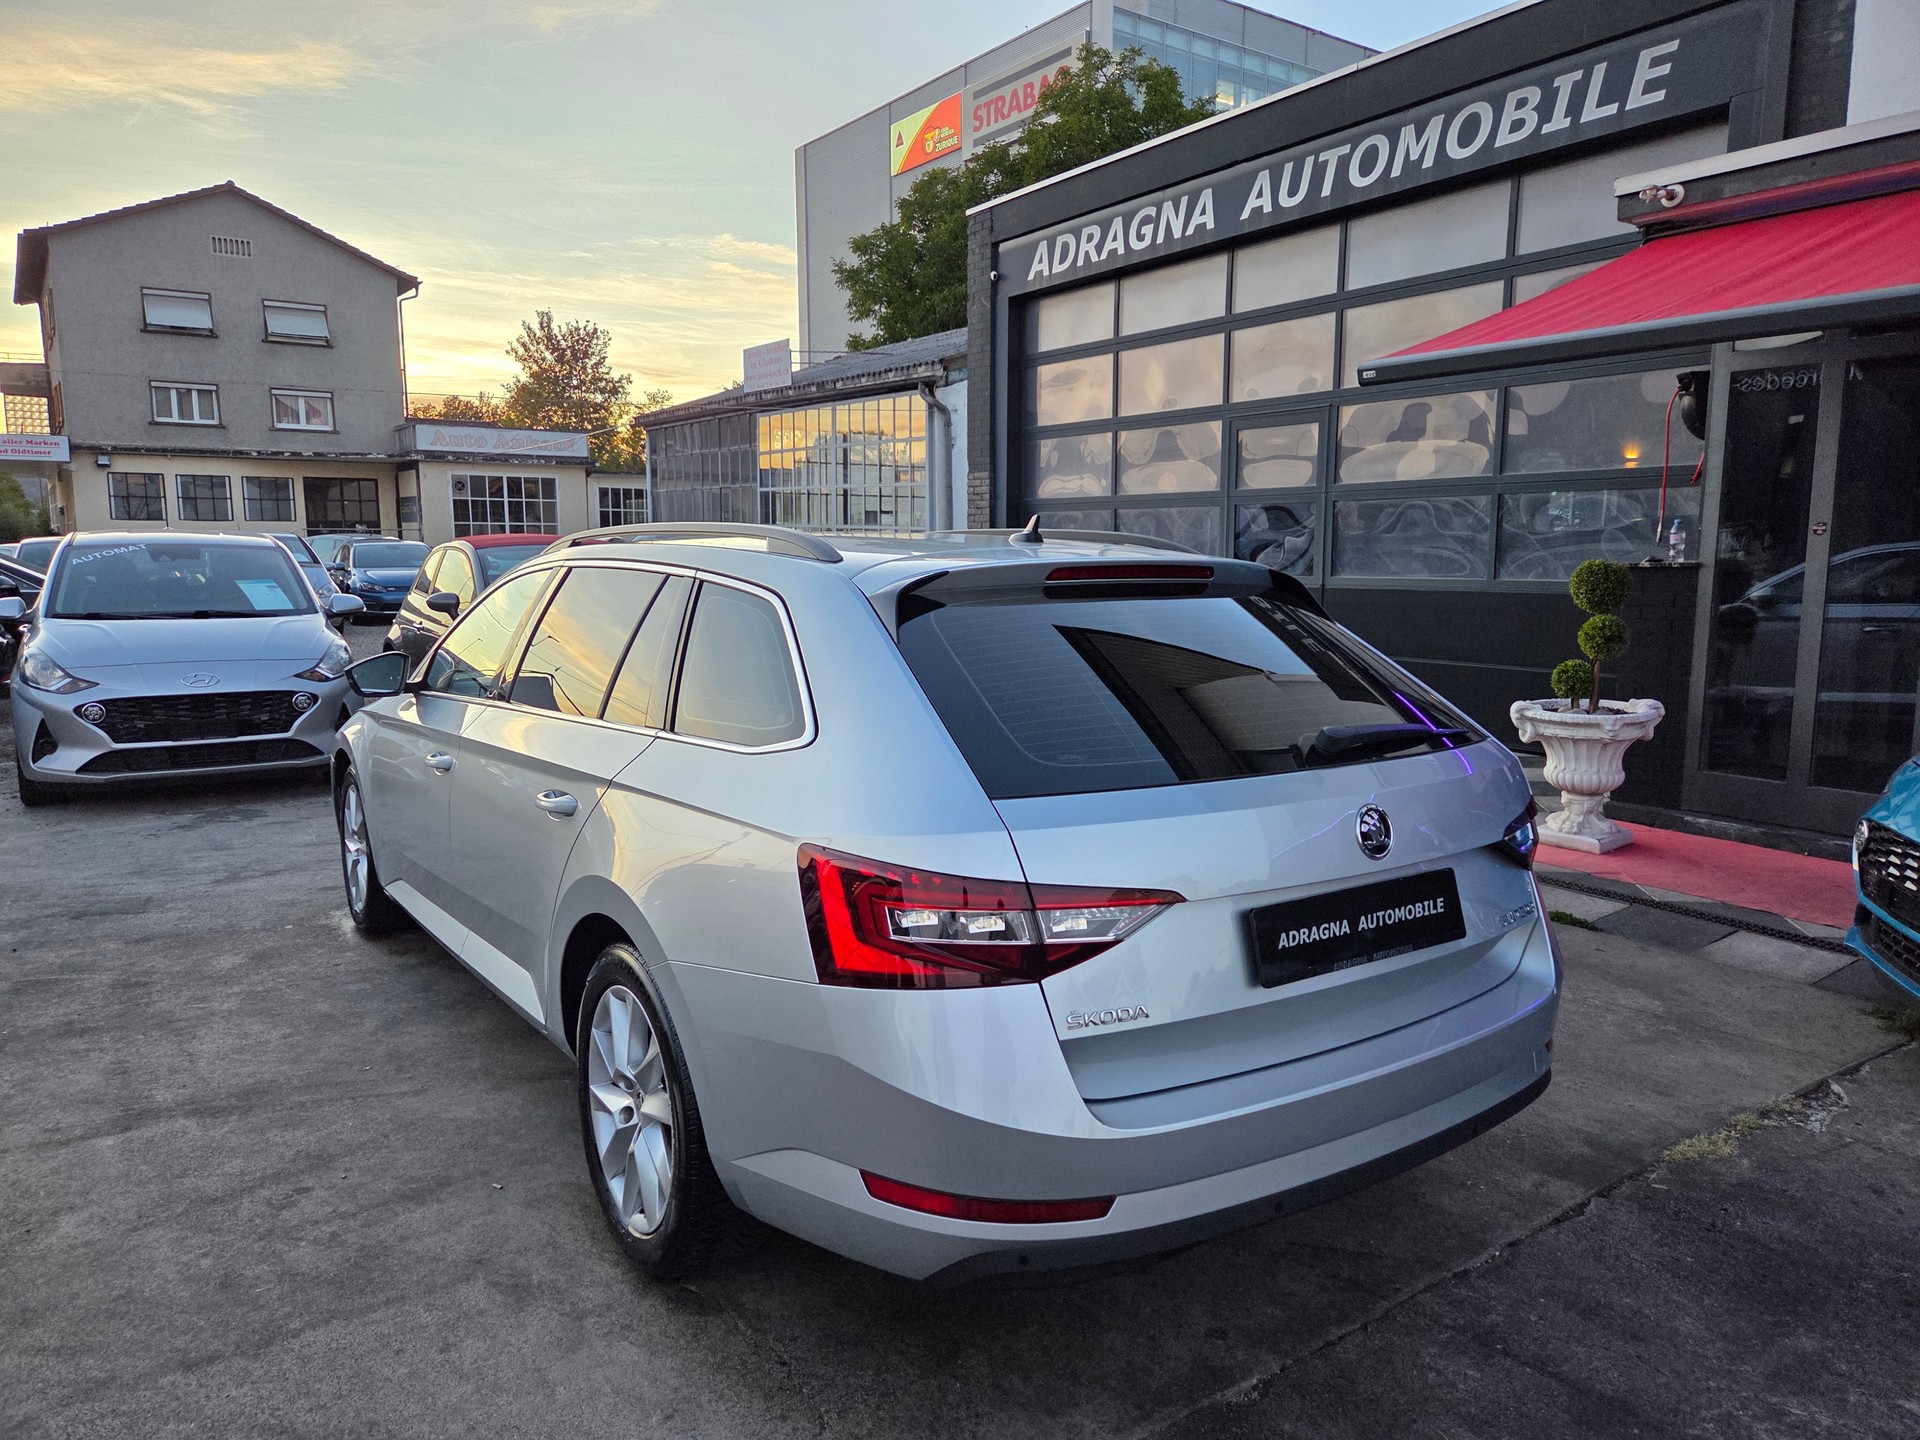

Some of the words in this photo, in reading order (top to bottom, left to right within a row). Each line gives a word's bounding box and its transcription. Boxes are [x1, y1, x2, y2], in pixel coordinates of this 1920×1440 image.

[936, 135, 959, 152] ZURIQUE
[1027, 187, 1216, 281] ADRAGNA
[1240, 39, 1680, 221] AUTOMOBILE
[25, 439, 60, 447] Marken
[430, 429, 488, 449] Auto
[10, 448, 52, 456] Oldtimer
[72, 543, 147, 565] AUTOMAT
[1278, 919, 1351, 950] ADRAGNA
[1358, 897, 1445, 932] AUTOMOBILE
[1066, 1004, 1150, 1031] ŠKODA
